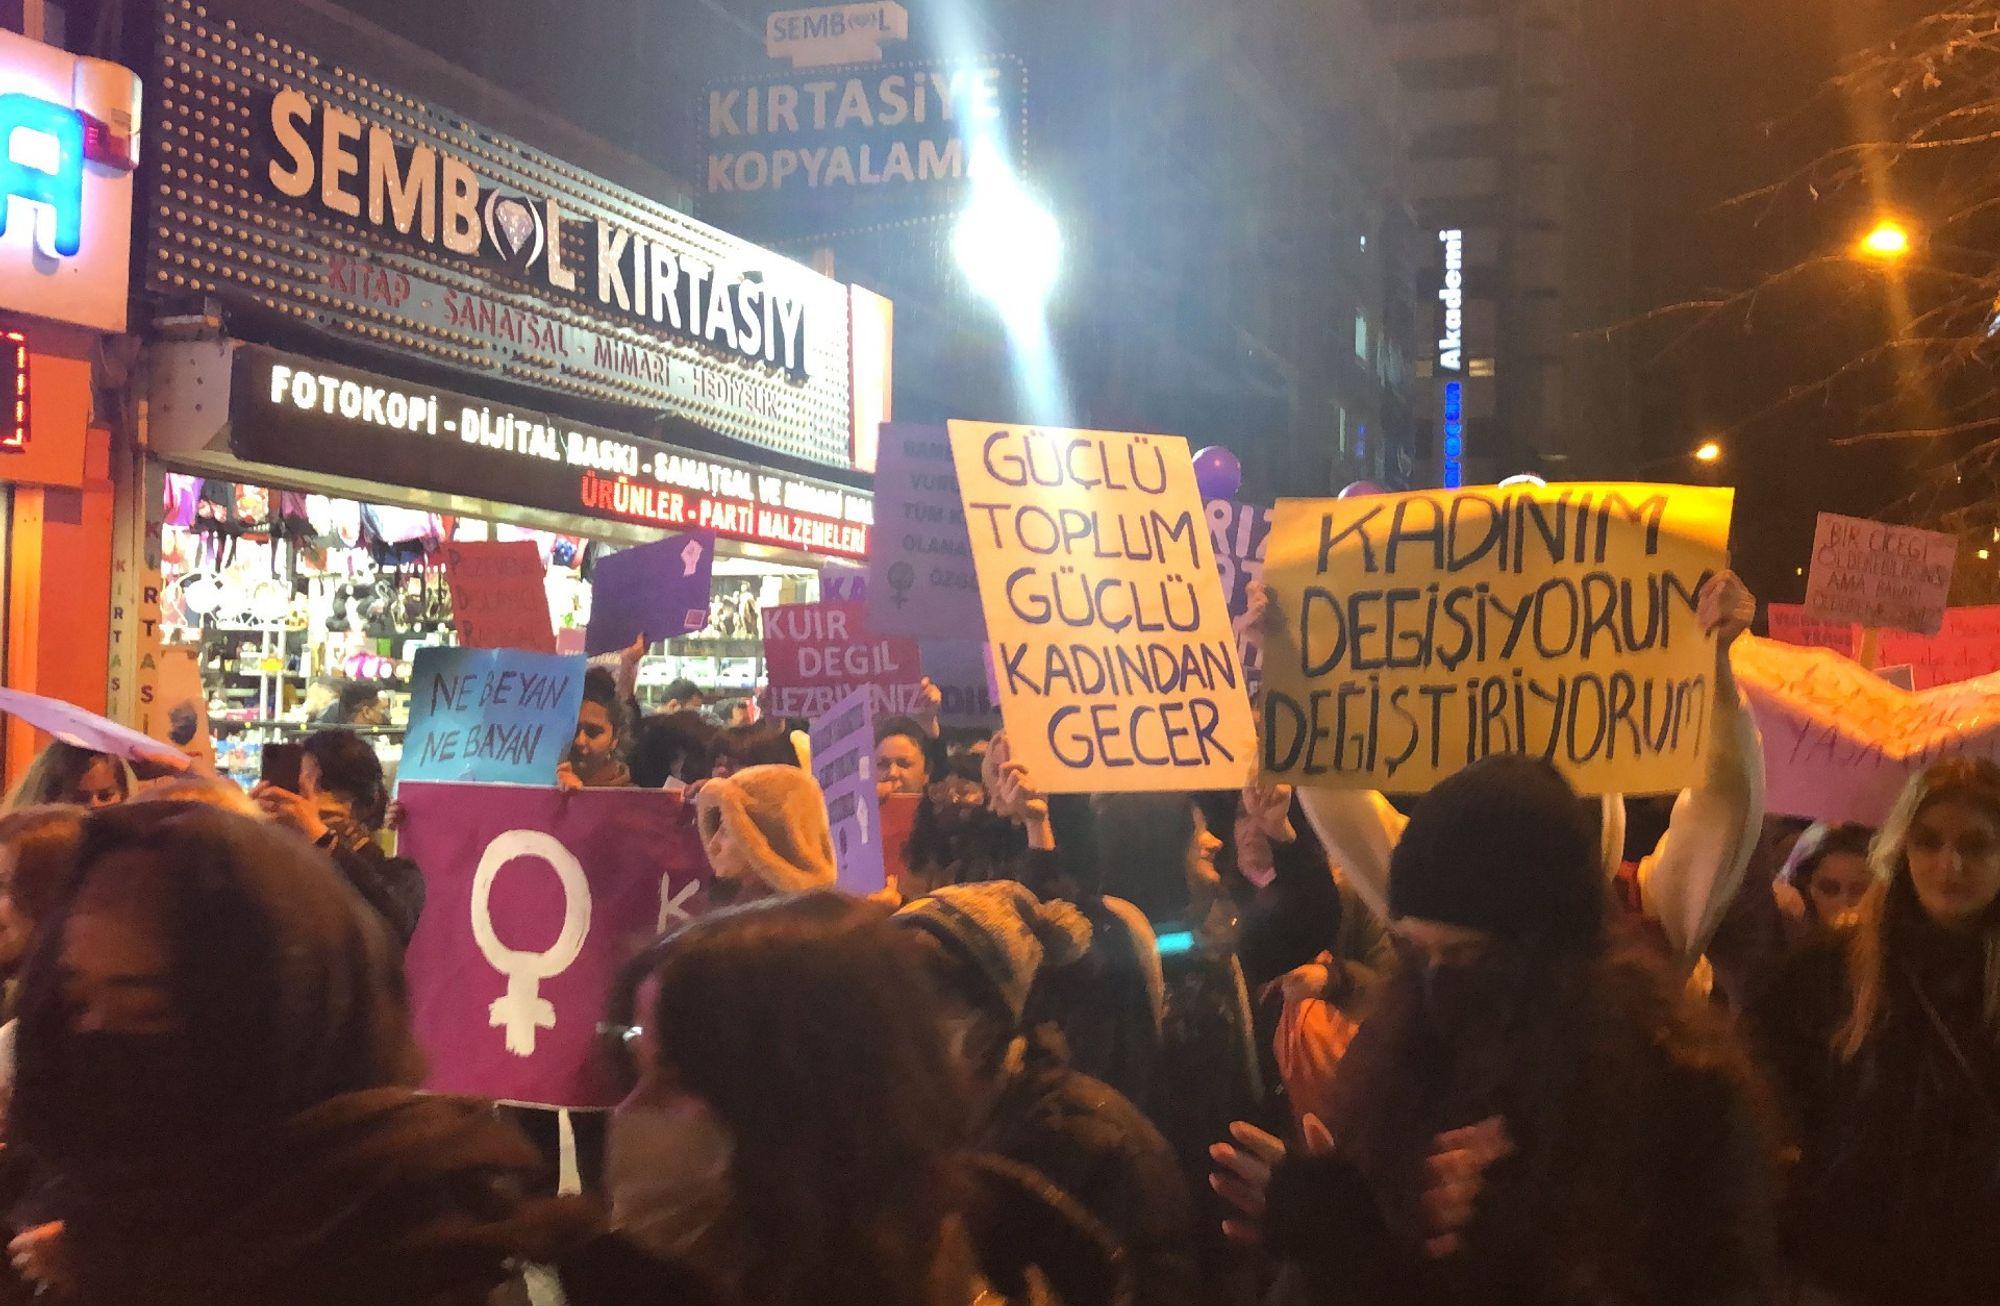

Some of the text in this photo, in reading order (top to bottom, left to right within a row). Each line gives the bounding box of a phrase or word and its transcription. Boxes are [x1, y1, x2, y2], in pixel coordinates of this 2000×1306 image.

[707, 138, 980, 193] KOPYALAM
[444, 287, 569, 357] SANATSAL
[1438, 229, 1462, 372] Akademi
[271, 365, 437, 435] FOTOKOPİ
[461, 406, 561, 461] DİJİTAL
[983, 428, 1167, 494] GÜÇLÜ
[581, 468, 685, 523] ÜRÜNLER
[700, 502, 754, 535] PARTİ
[970, 501, 1201, 569] TOPLUM
[1317, 487, 1669, 574] KADINIM
[1005, 565, 1201, 632] GÜÇLÜ
[431, 670, 569, 716] NE BEYAN
[1000, 640, 1237, 697] KADINDAN
[420, 722, 544, 767] NE BAYAN
[1047, 699, 1235, 769] GECER
